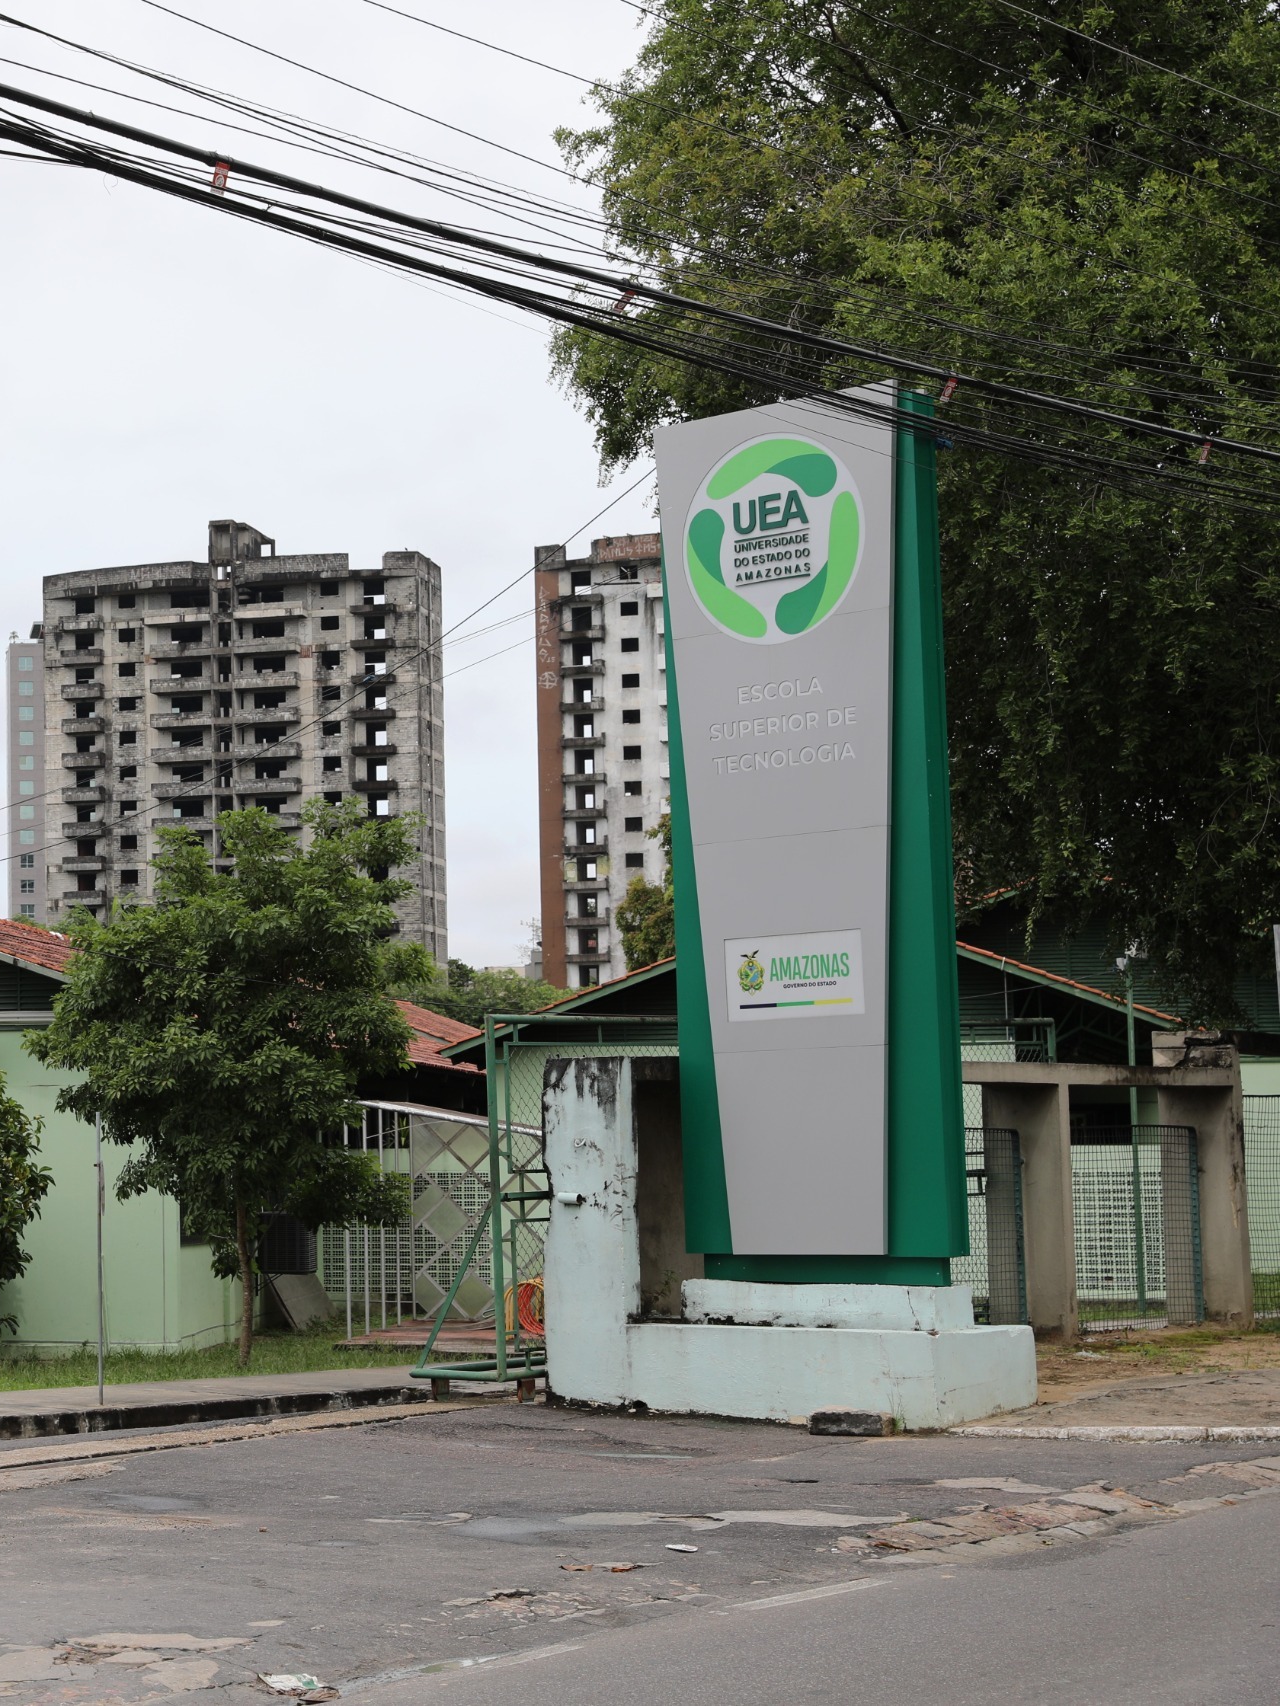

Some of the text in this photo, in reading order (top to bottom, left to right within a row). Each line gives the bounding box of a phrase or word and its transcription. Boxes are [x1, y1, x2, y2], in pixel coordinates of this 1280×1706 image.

[732, 489, 809, 534] UEA
[734, 533, 809, 553] UNIVERSIDADE
[734, 548, 811, 568] DO ESTADO DO
[736, 562, 810, 582] AMAZONAS
[737, 676, 823, 705] ESCOLA
[709, 706, 857, 742] SUPERIOR DE
[712, 742, 856, 775] TECNOLOGIA
[770, 952, 849, 981] AMAZONAS
